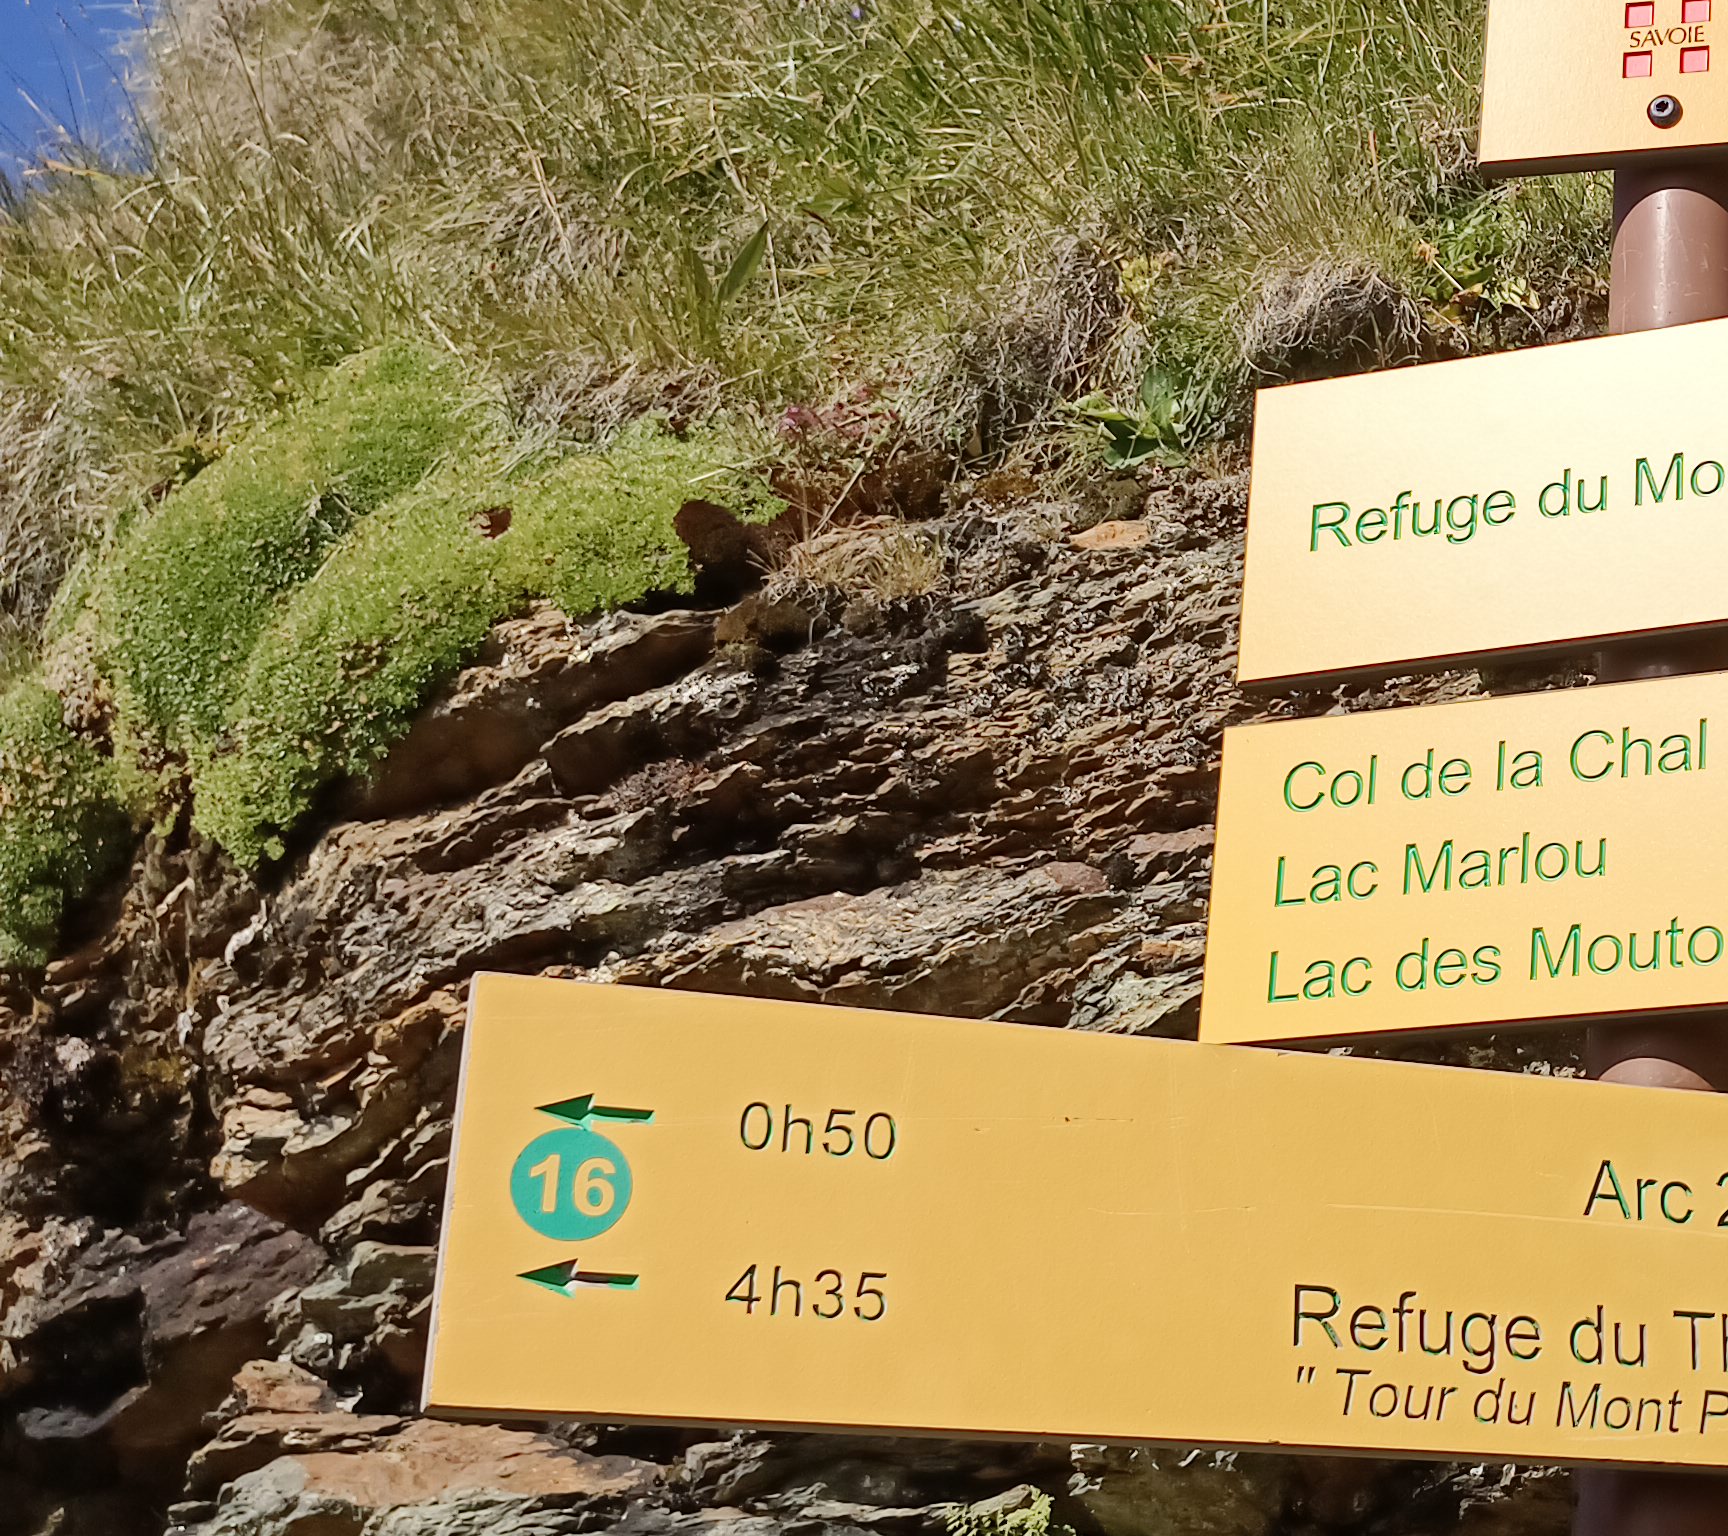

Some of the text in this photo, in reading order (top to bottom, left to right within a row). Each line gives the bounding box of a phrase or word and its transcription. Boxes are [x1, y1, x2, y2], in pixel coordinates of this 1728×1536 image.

[1629, 25, 1706, 48] SAVOIE
[1310, 490, 1516, 552] Refuge
[1539, 468, 1608, 518] du
[1284, 718, 1707, 812] Col de la Chal
[1275, 832, 1606, 907] Lac Marlou
[1267, 951, 1372, 1003] Lac
[1396, 937, 1501, 992] des
[740, 1102, 896, 1159] 0h50
[529, 1154, 616, 1217] 16
[1583, 1160, 1694, 1224] Arc
[725, 1264, 887, 1321] 4h35
[1293, 1284, 1542, 1371] Refuge
[1570, 1305, 1646, 1367] du
[1336, 1368, 1458, 1421] Tour
[1477, 1374, 1537, 1428] du
[1556, 1381, 1682, 1433] Mont
